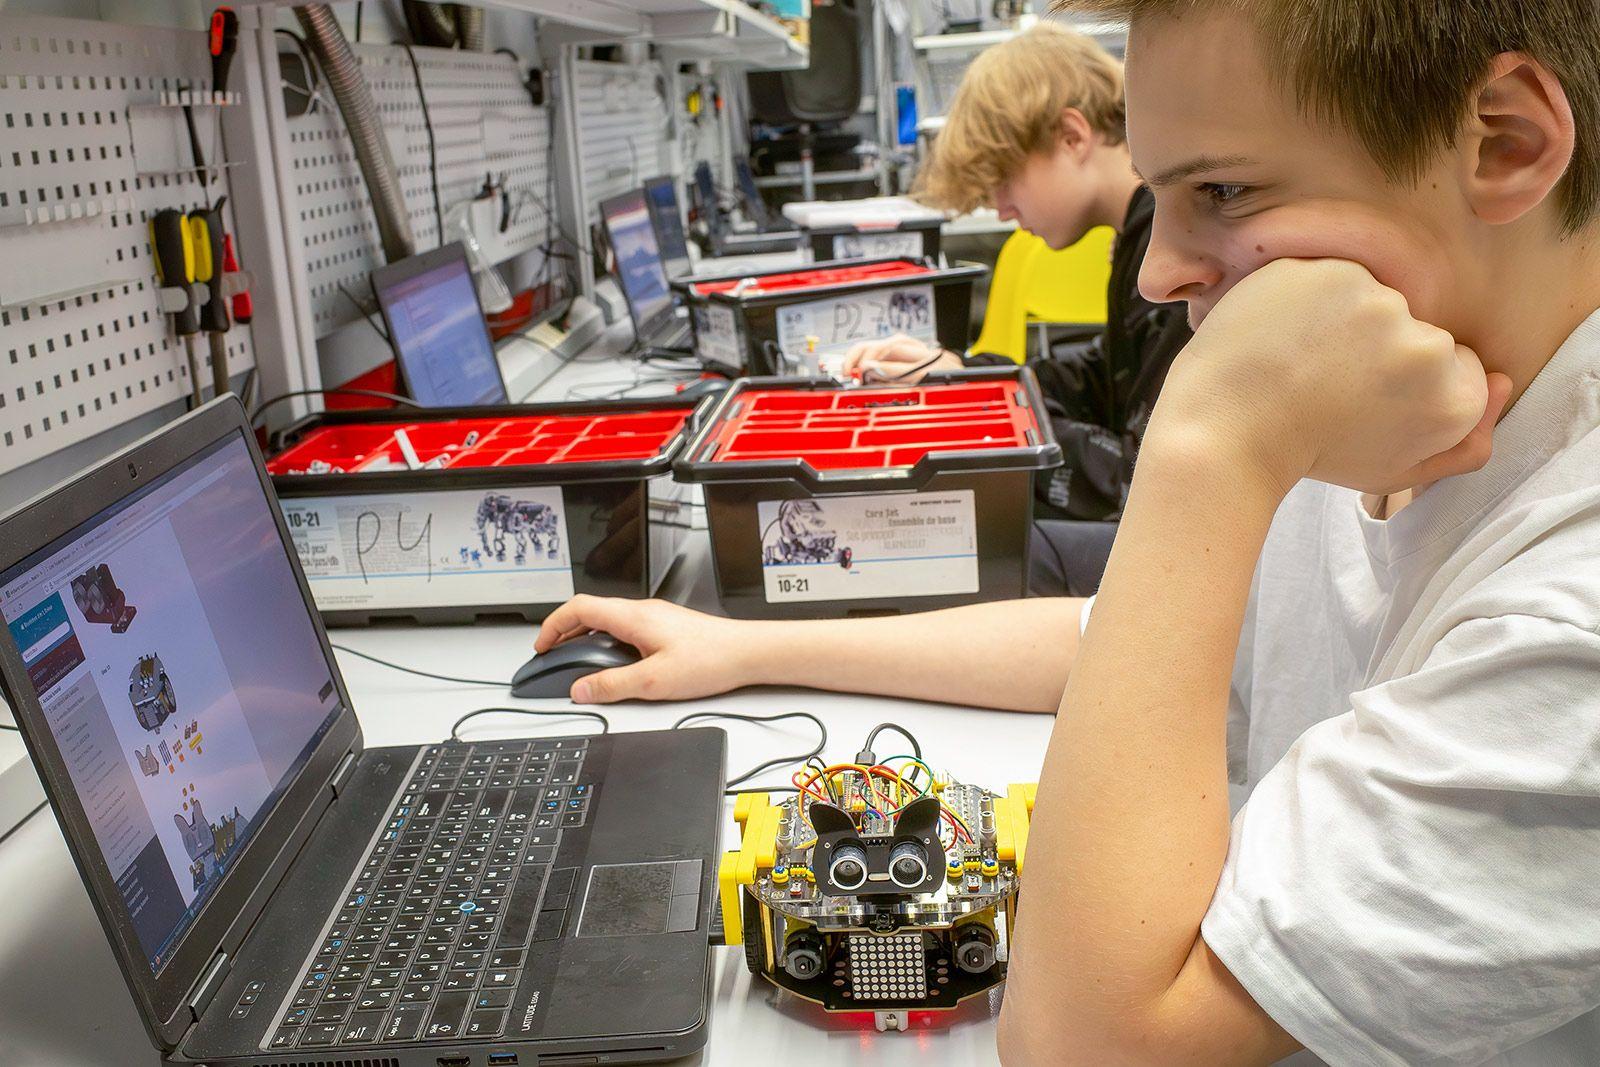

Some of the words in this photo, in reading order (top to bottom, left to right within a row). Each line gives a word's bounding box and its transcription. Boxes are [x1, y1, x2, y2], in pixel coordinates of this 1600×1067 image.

[287, 511, 320, 527] 10-21
[778, 578, 809, 593] 10-21
[370, 978, 382, 986] W
[392, 1016, 402, 1027] Lock
[388, 1026, 398, 1037] Caps
